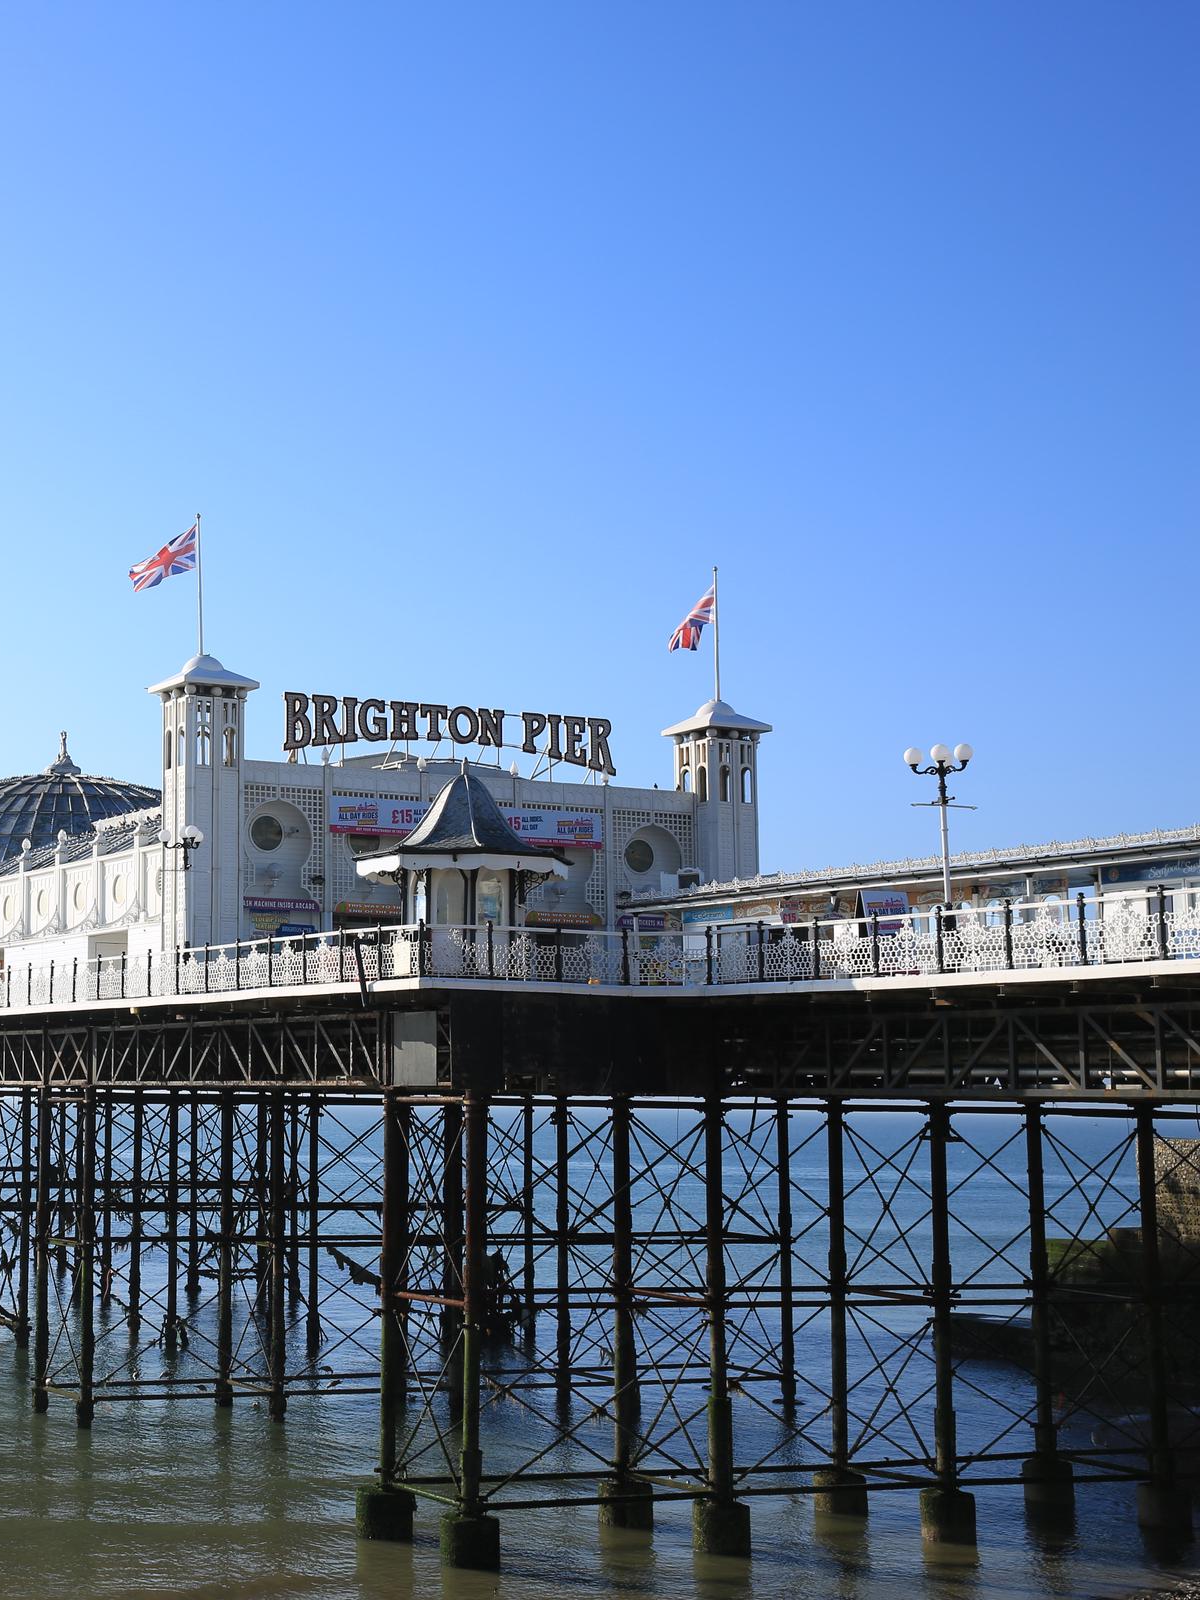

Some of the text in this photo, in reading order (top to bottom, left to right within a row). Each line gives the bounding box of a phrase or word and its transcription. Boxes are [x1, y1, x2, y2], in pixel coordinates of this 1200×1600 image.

[284, 691, 616, 776] BRIGHTON PIER
[392, 809, 413, 824] £15
[508, 816, 521, 831] 15
[253, 900, 276, 908] MACHINE
[277, 901, 294, 909] INSIDE
[295, 902, 315, 910] ARCADE
